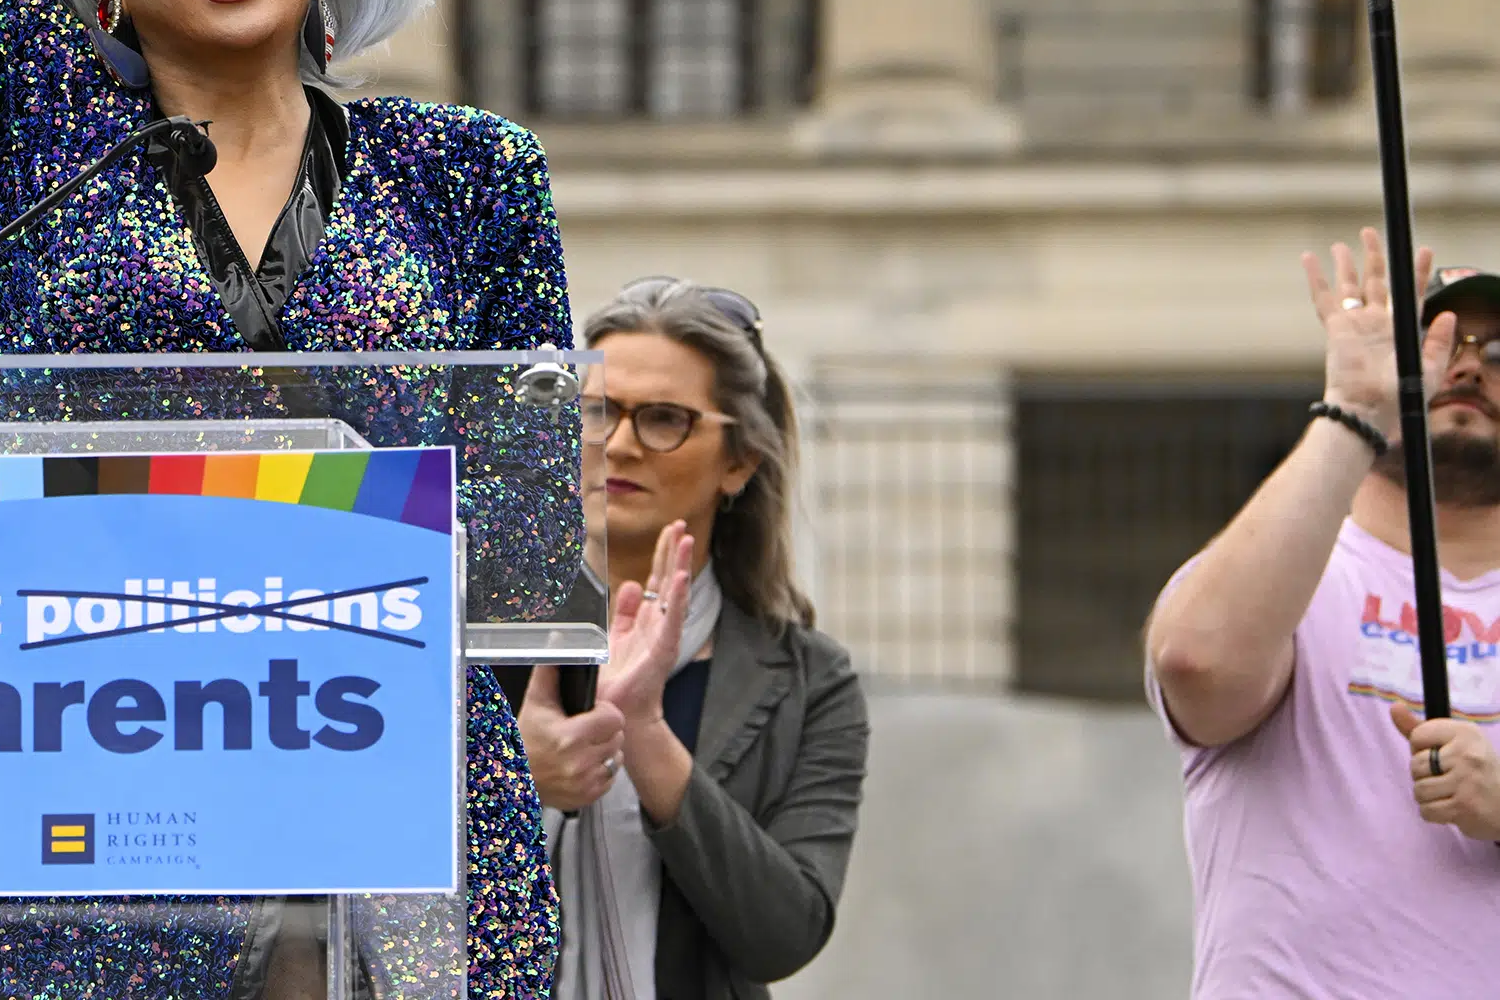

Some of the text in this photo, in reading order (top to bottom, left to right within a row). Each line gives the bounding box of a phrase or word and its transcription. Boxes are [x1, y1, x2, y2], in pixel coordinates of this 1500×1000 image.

[26, 576, 422, 643] politicians
[106, 811, 197, 826] HUMAN
[106, 832, 197, 848] RIGHTS
